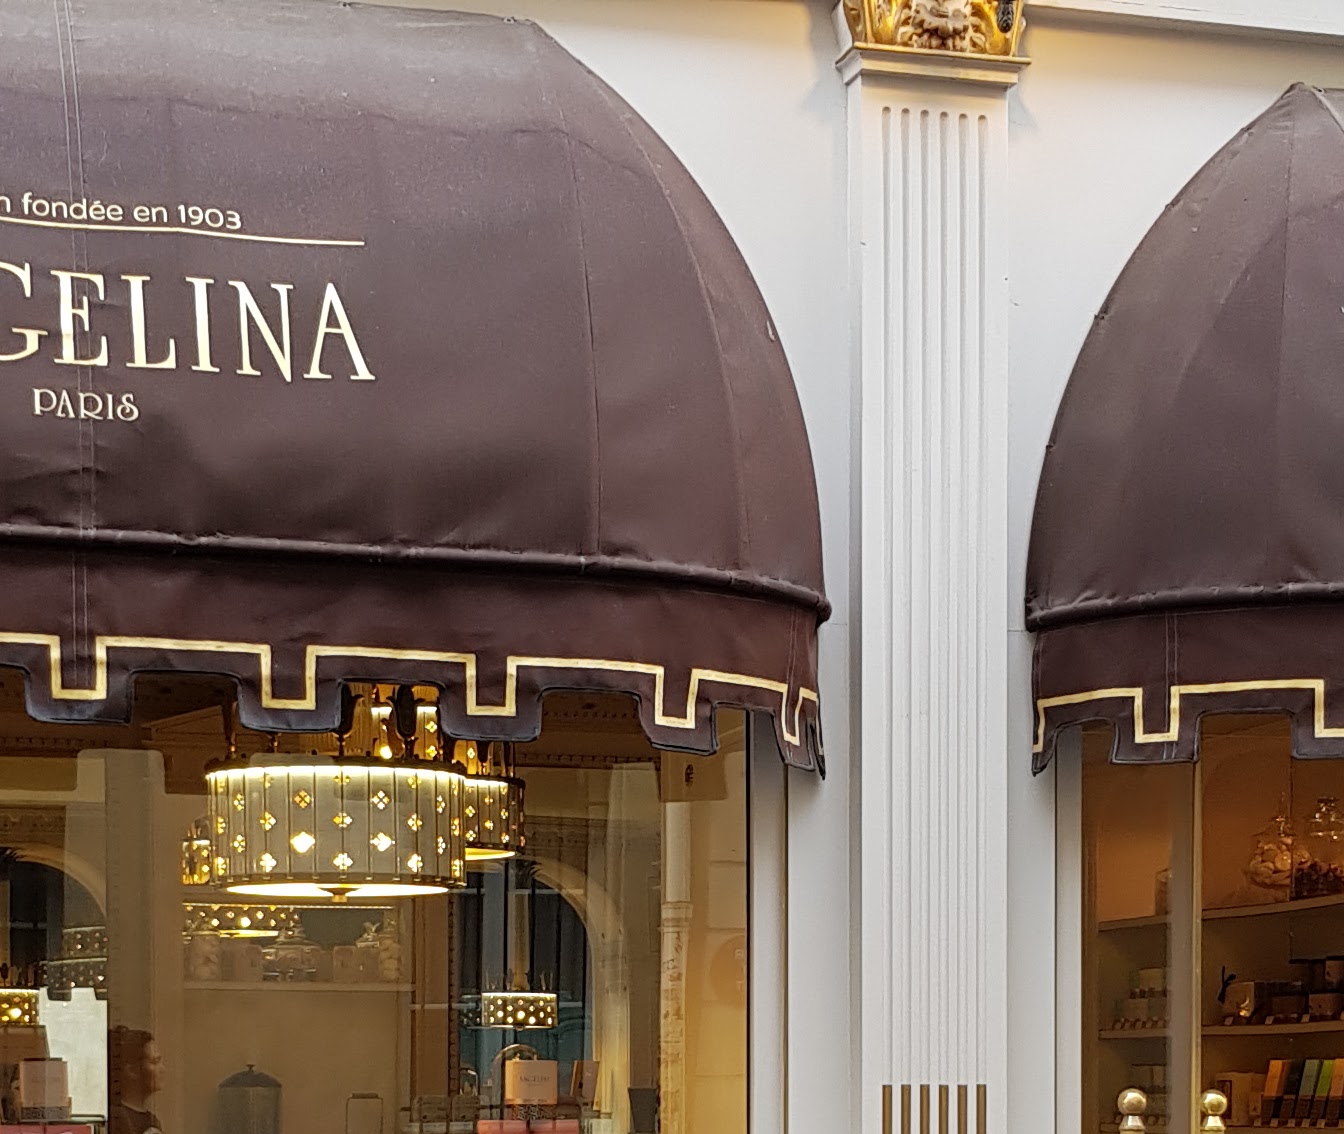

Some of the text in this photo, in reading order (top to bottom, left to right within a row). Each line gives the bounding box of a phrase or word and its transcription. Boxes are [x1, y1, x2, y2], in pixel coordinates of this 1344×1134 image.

[21, 191, 124, 222] fondée
[133, 205, 168, 223] en
[177, 204, 242, 230] 1903
[33, 388, 140, 421] PARIS
